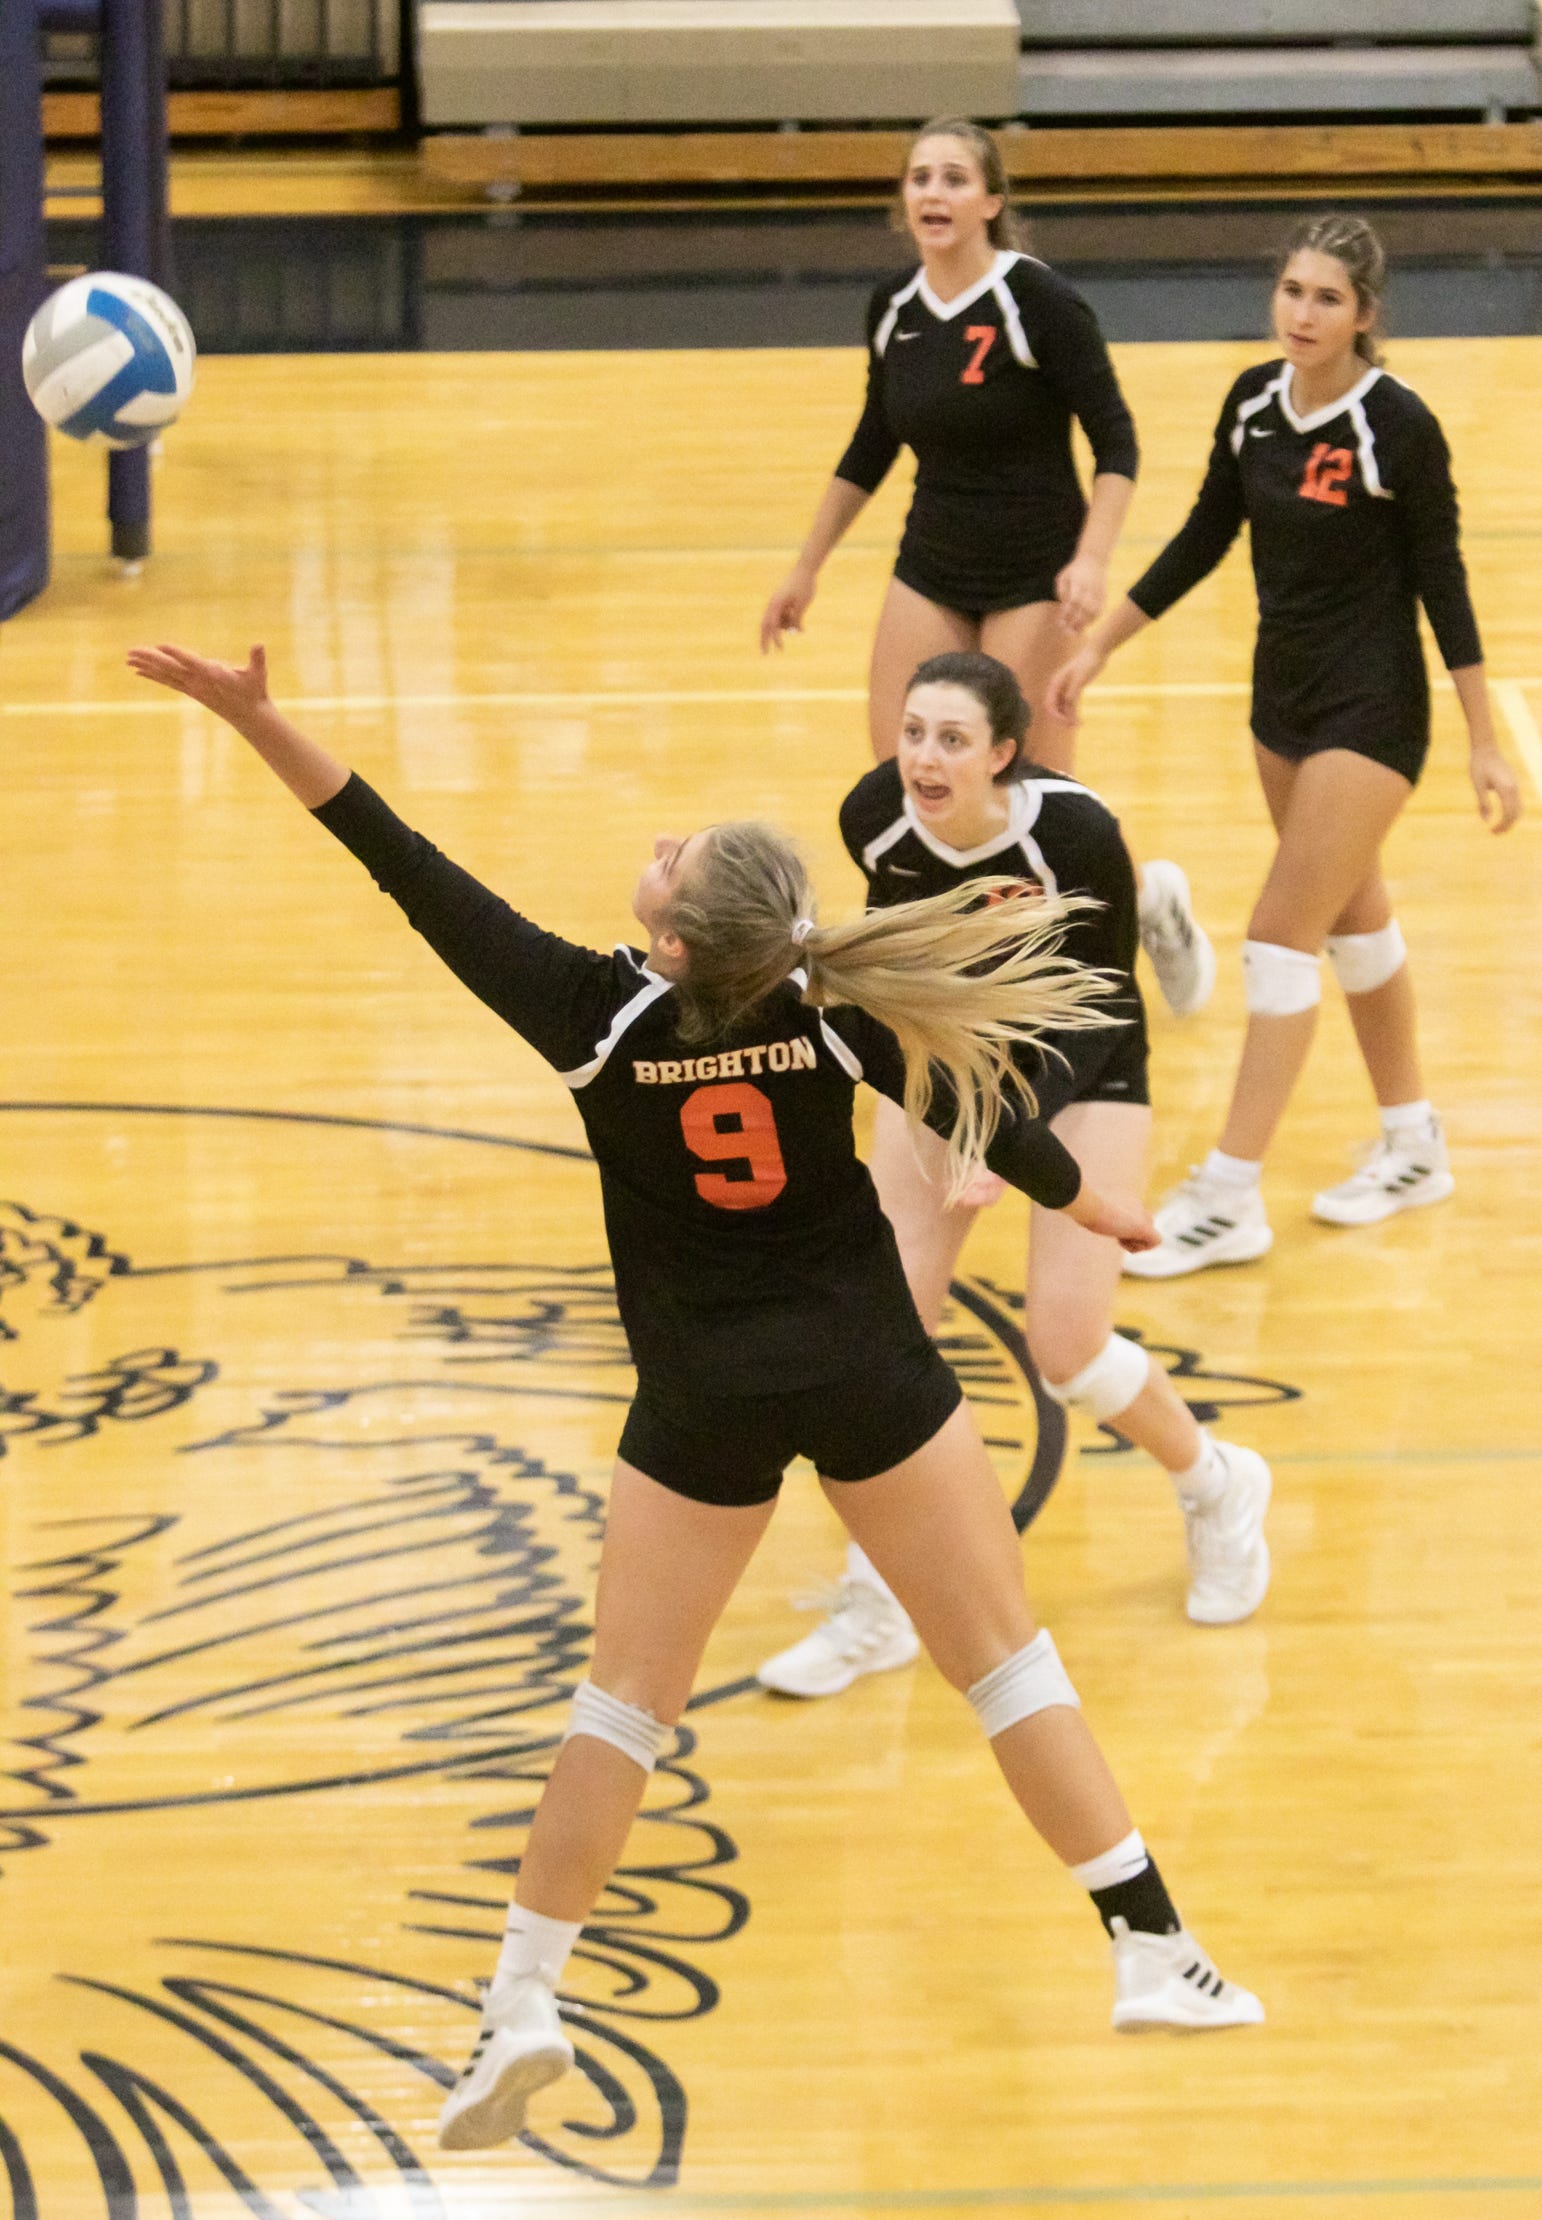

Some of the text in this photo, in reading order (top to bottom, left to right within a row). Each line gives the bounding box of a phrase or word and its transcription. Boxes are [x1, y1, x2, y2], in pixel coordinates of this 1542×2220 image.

[961, 325, 997, 385] 7
[1298, 442, 1353, 507] 12
[632, 1035, 817, 1084] BRIGHTON
[680, 1082, 788, 1210] 9
